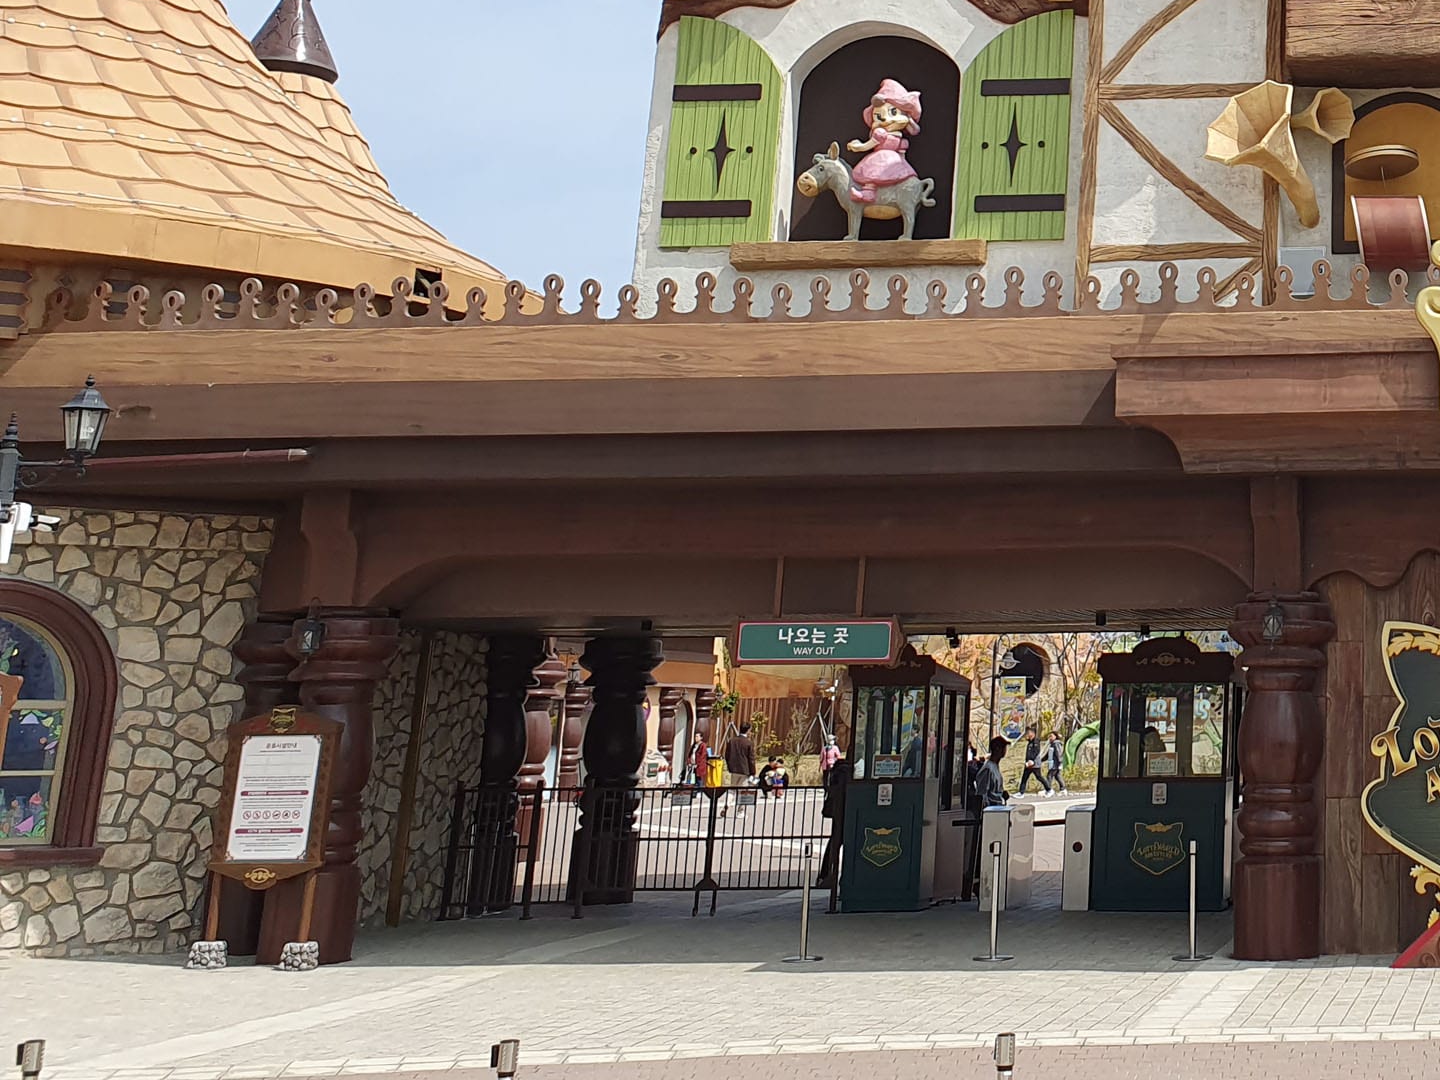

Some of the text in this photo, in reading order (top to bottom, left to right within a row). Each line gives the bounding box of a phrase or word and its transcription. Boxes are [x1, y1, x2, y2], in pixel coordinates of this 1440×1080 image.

[778, 627, 849, 644] 나오는 곳
[793, 647, 835, 655] WAY OUT
